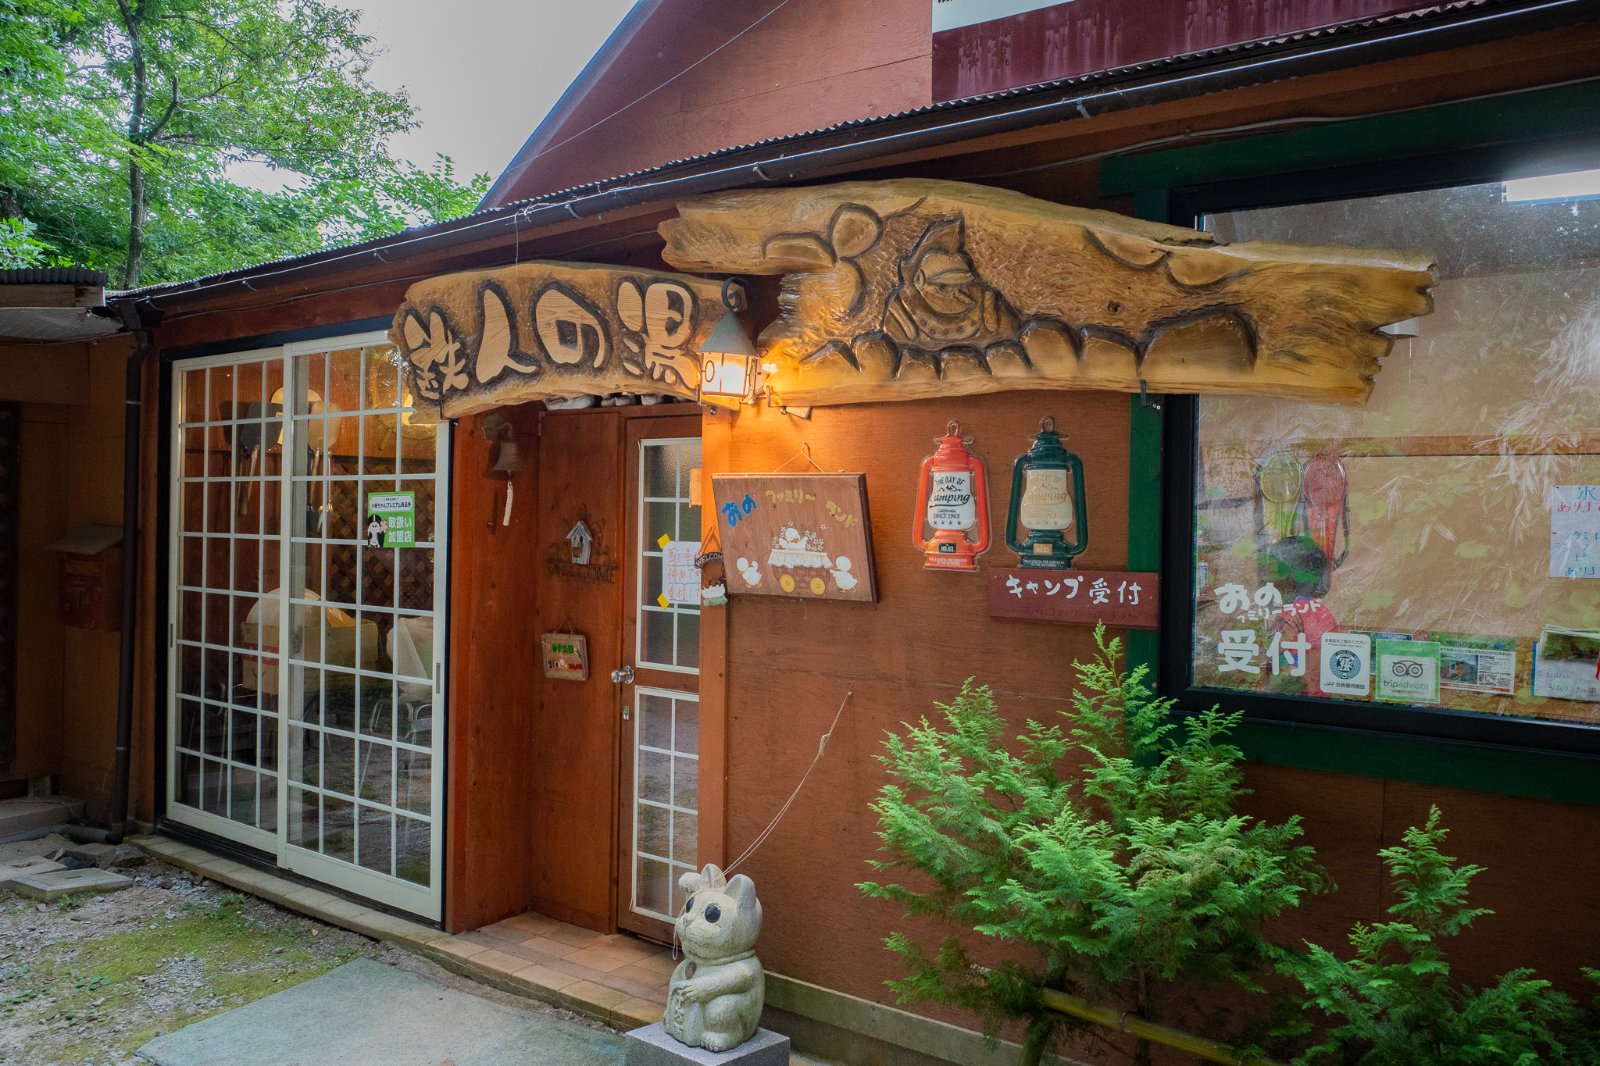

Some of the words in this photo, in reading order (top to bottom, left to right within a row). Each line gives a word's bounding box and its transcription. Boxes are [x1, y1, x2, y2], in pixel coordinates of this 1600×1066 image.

[1557, 501, 1600, 512] ありま
[1006, 575, 1142, 605] キャンプ受付
[1214, 582, 1282, 614] おの
[1217, 629, 1311, 677] 受付
